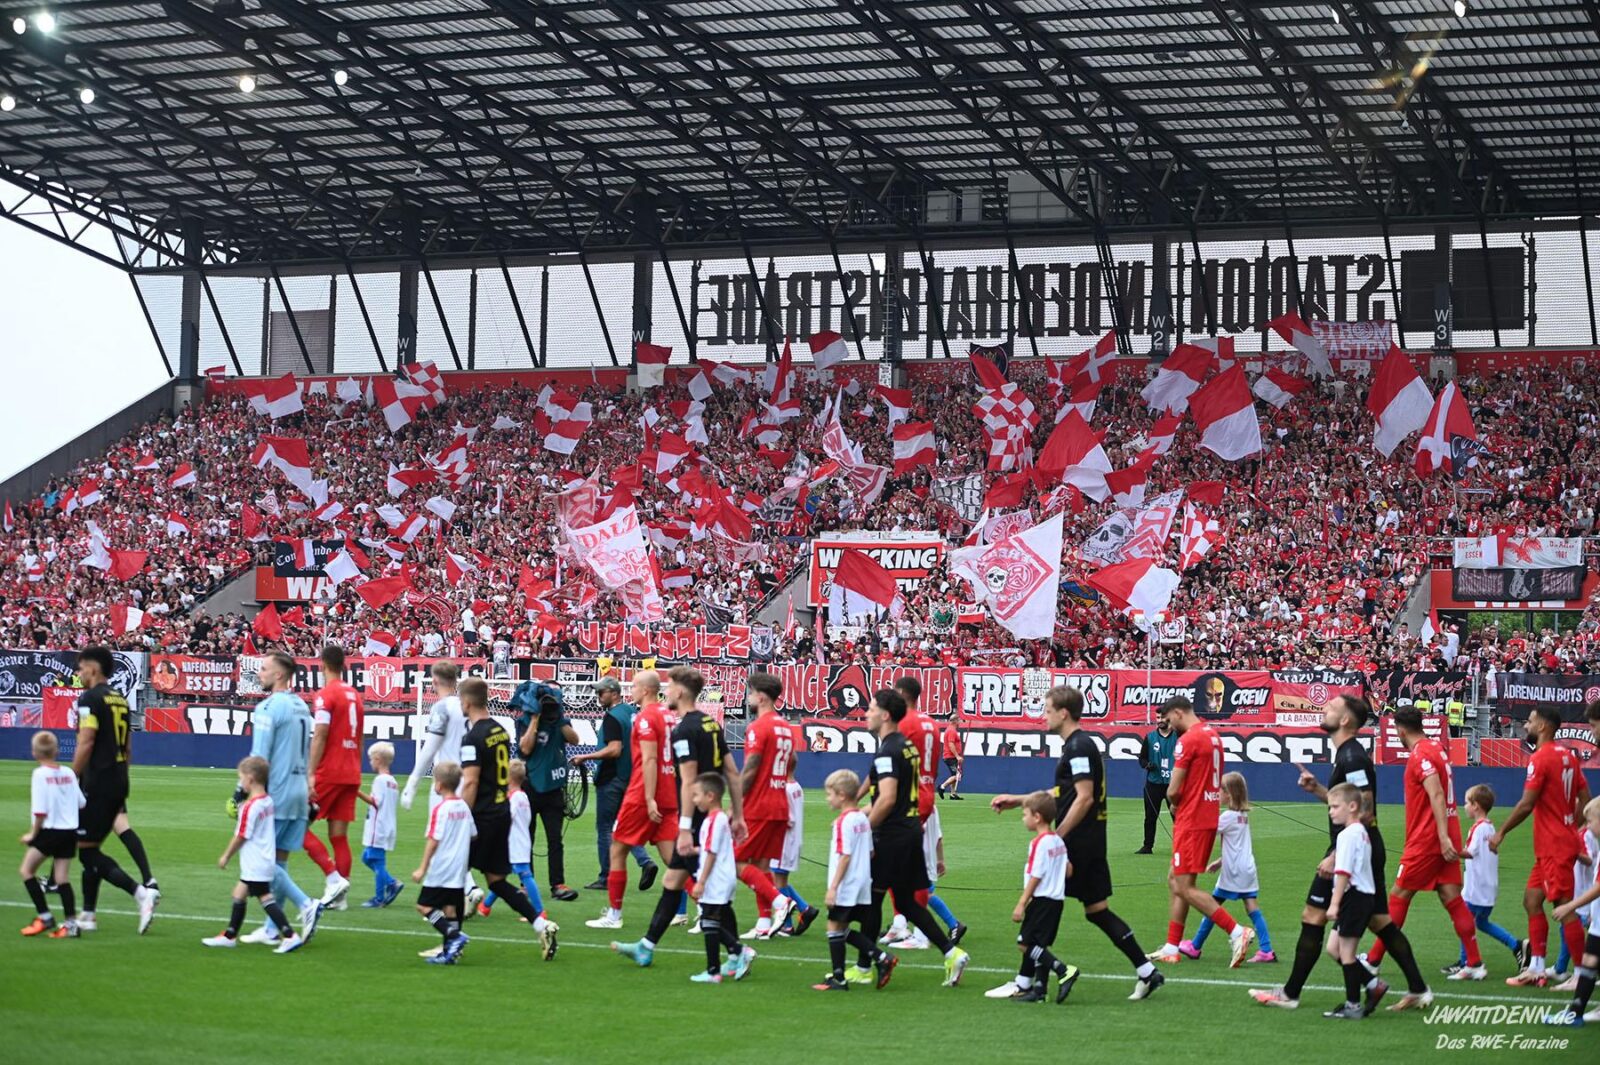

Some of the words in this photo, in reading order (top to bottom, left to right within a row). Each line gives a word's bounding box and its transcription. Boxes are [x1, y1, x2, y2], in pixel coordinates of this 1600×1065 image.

[1152, 315, 1165, 329] W
[1434, 309, 1449, 322] W
[1436, 324, 1447, 340] 3
[398, 337, 410, 349] W
[33, 653, 74, 678] Löwen
[15, 681, 41, 696] 1980
[185, 675, 231, 691] ESSEN
[1503, 678, 1556, 702] ADRENALIN
[1557, 688, 1583, 702] BOYS
[1230, 687, 1270, 706] CREW
[1294, 714, 1317, 723] BANDA
[496, 743, 509, 786] 8
